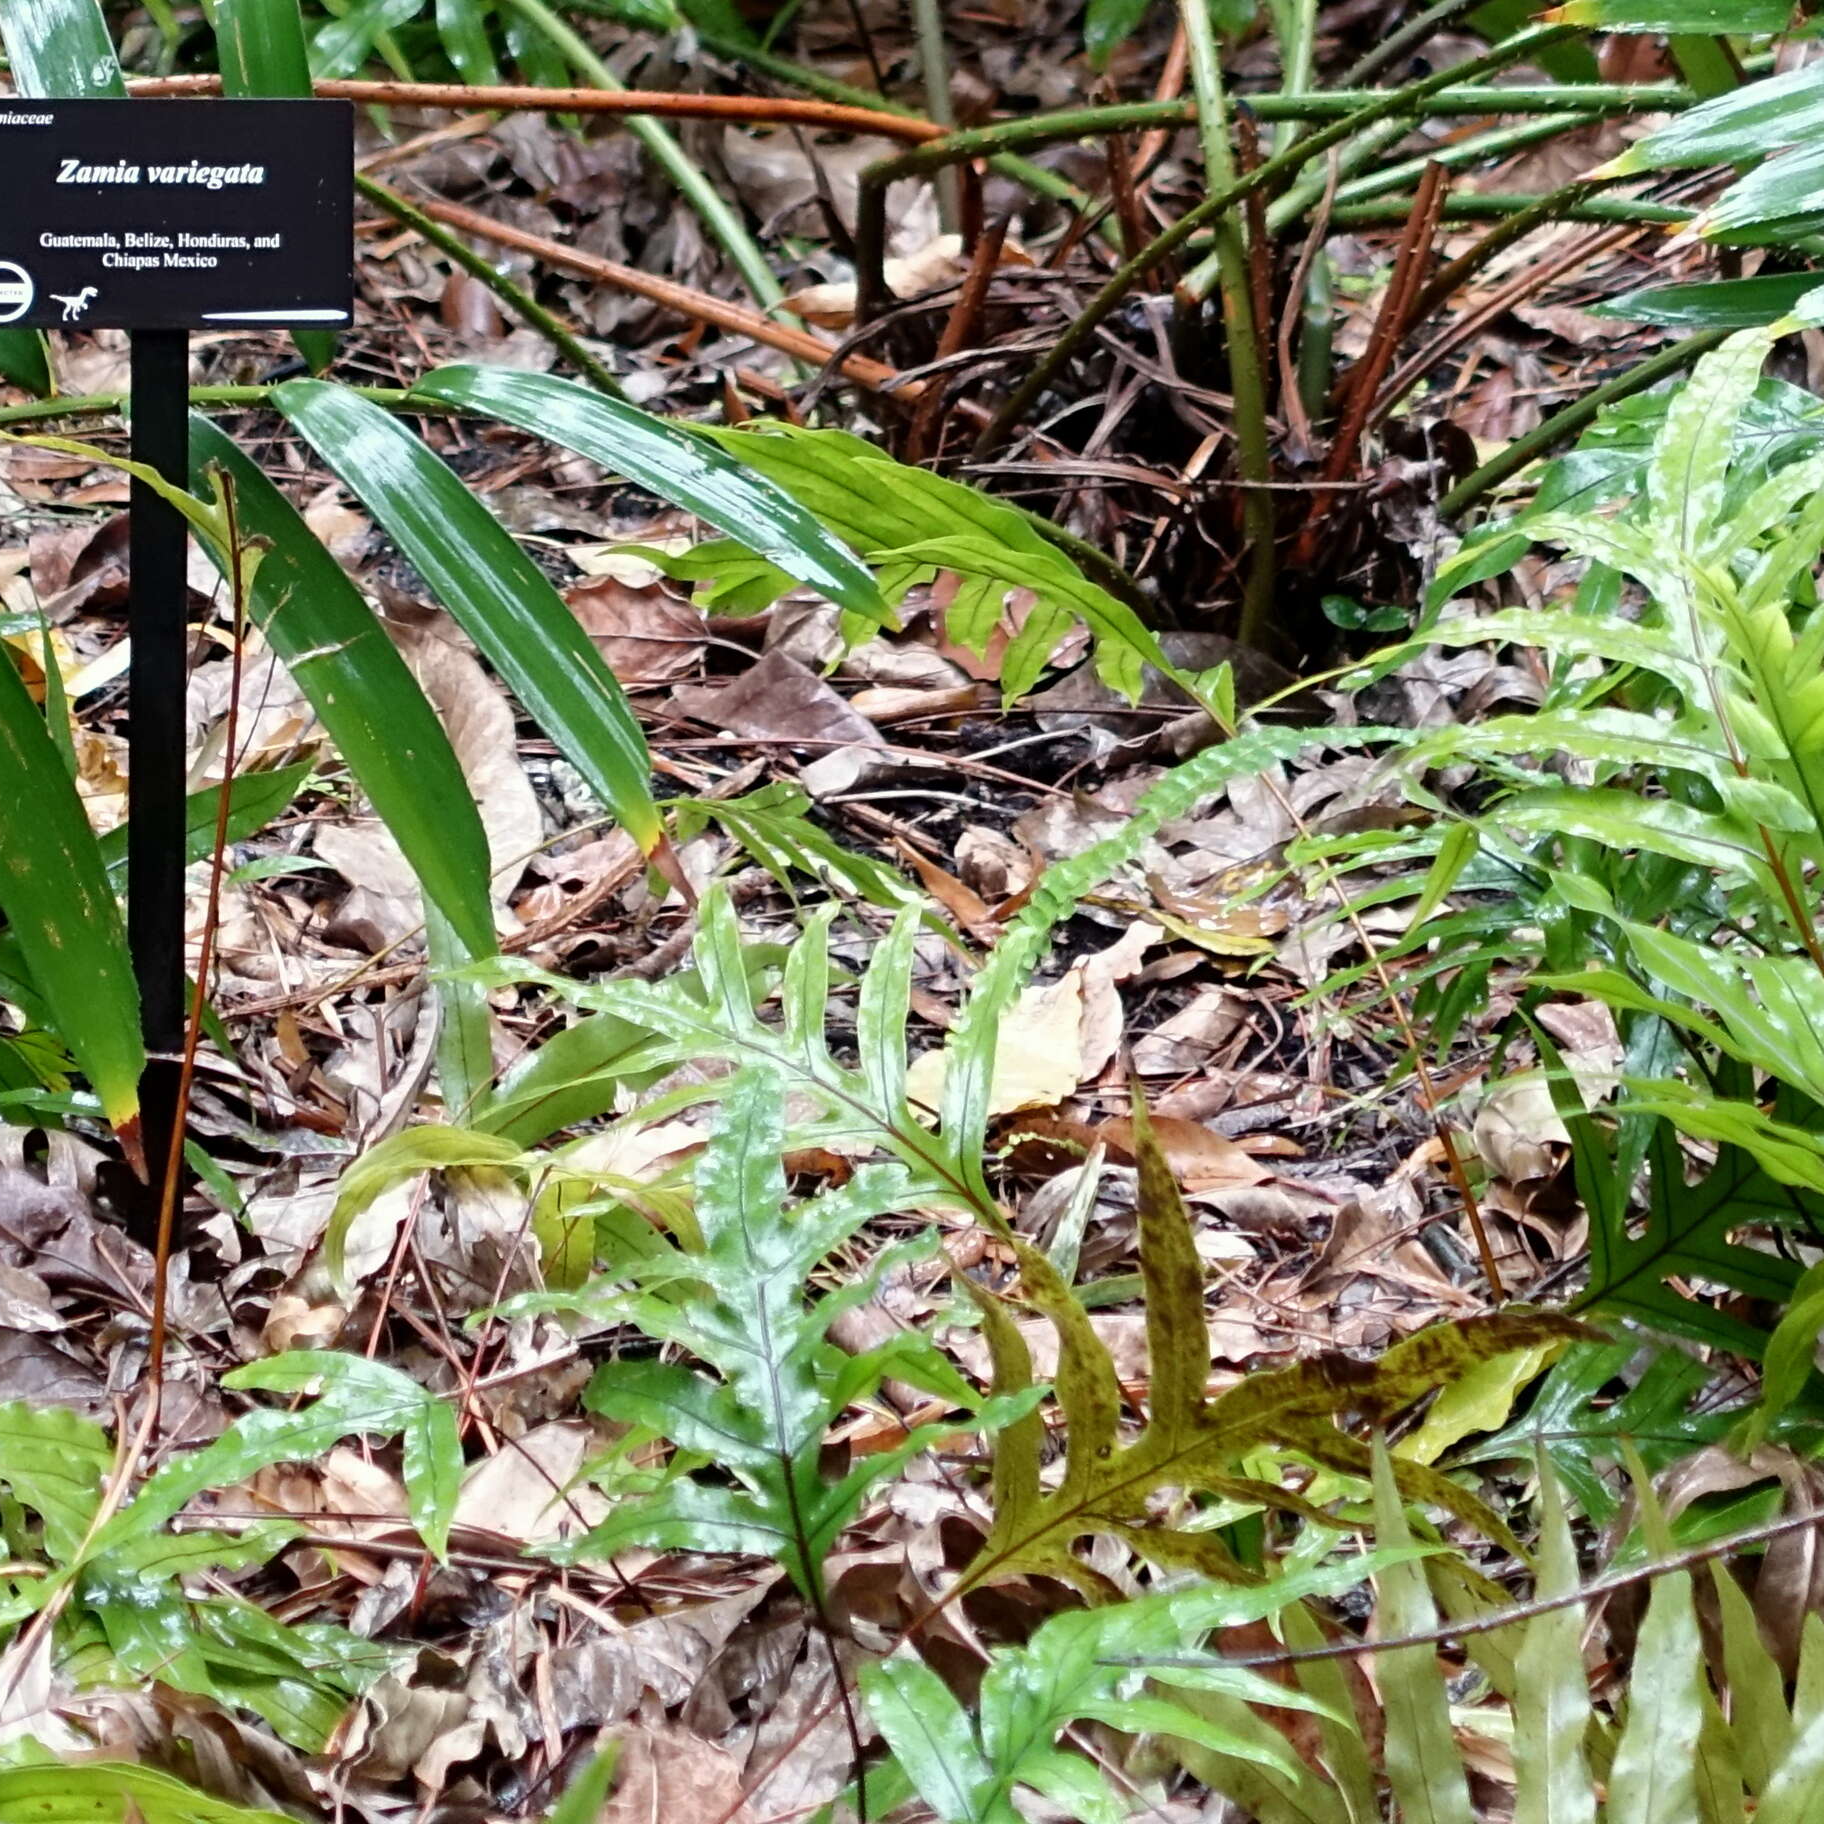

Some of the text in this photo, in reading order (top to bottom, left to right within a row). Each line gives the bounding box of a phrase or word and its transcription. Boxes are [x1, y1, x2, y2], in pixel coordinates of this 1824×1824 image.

[56, 159, 264, 189] Zamia variegata
[39, 232, 280, 250] Guatemala, Belize, Honduras, and
[101, 252, 217, 270] Chiapas Mexico
